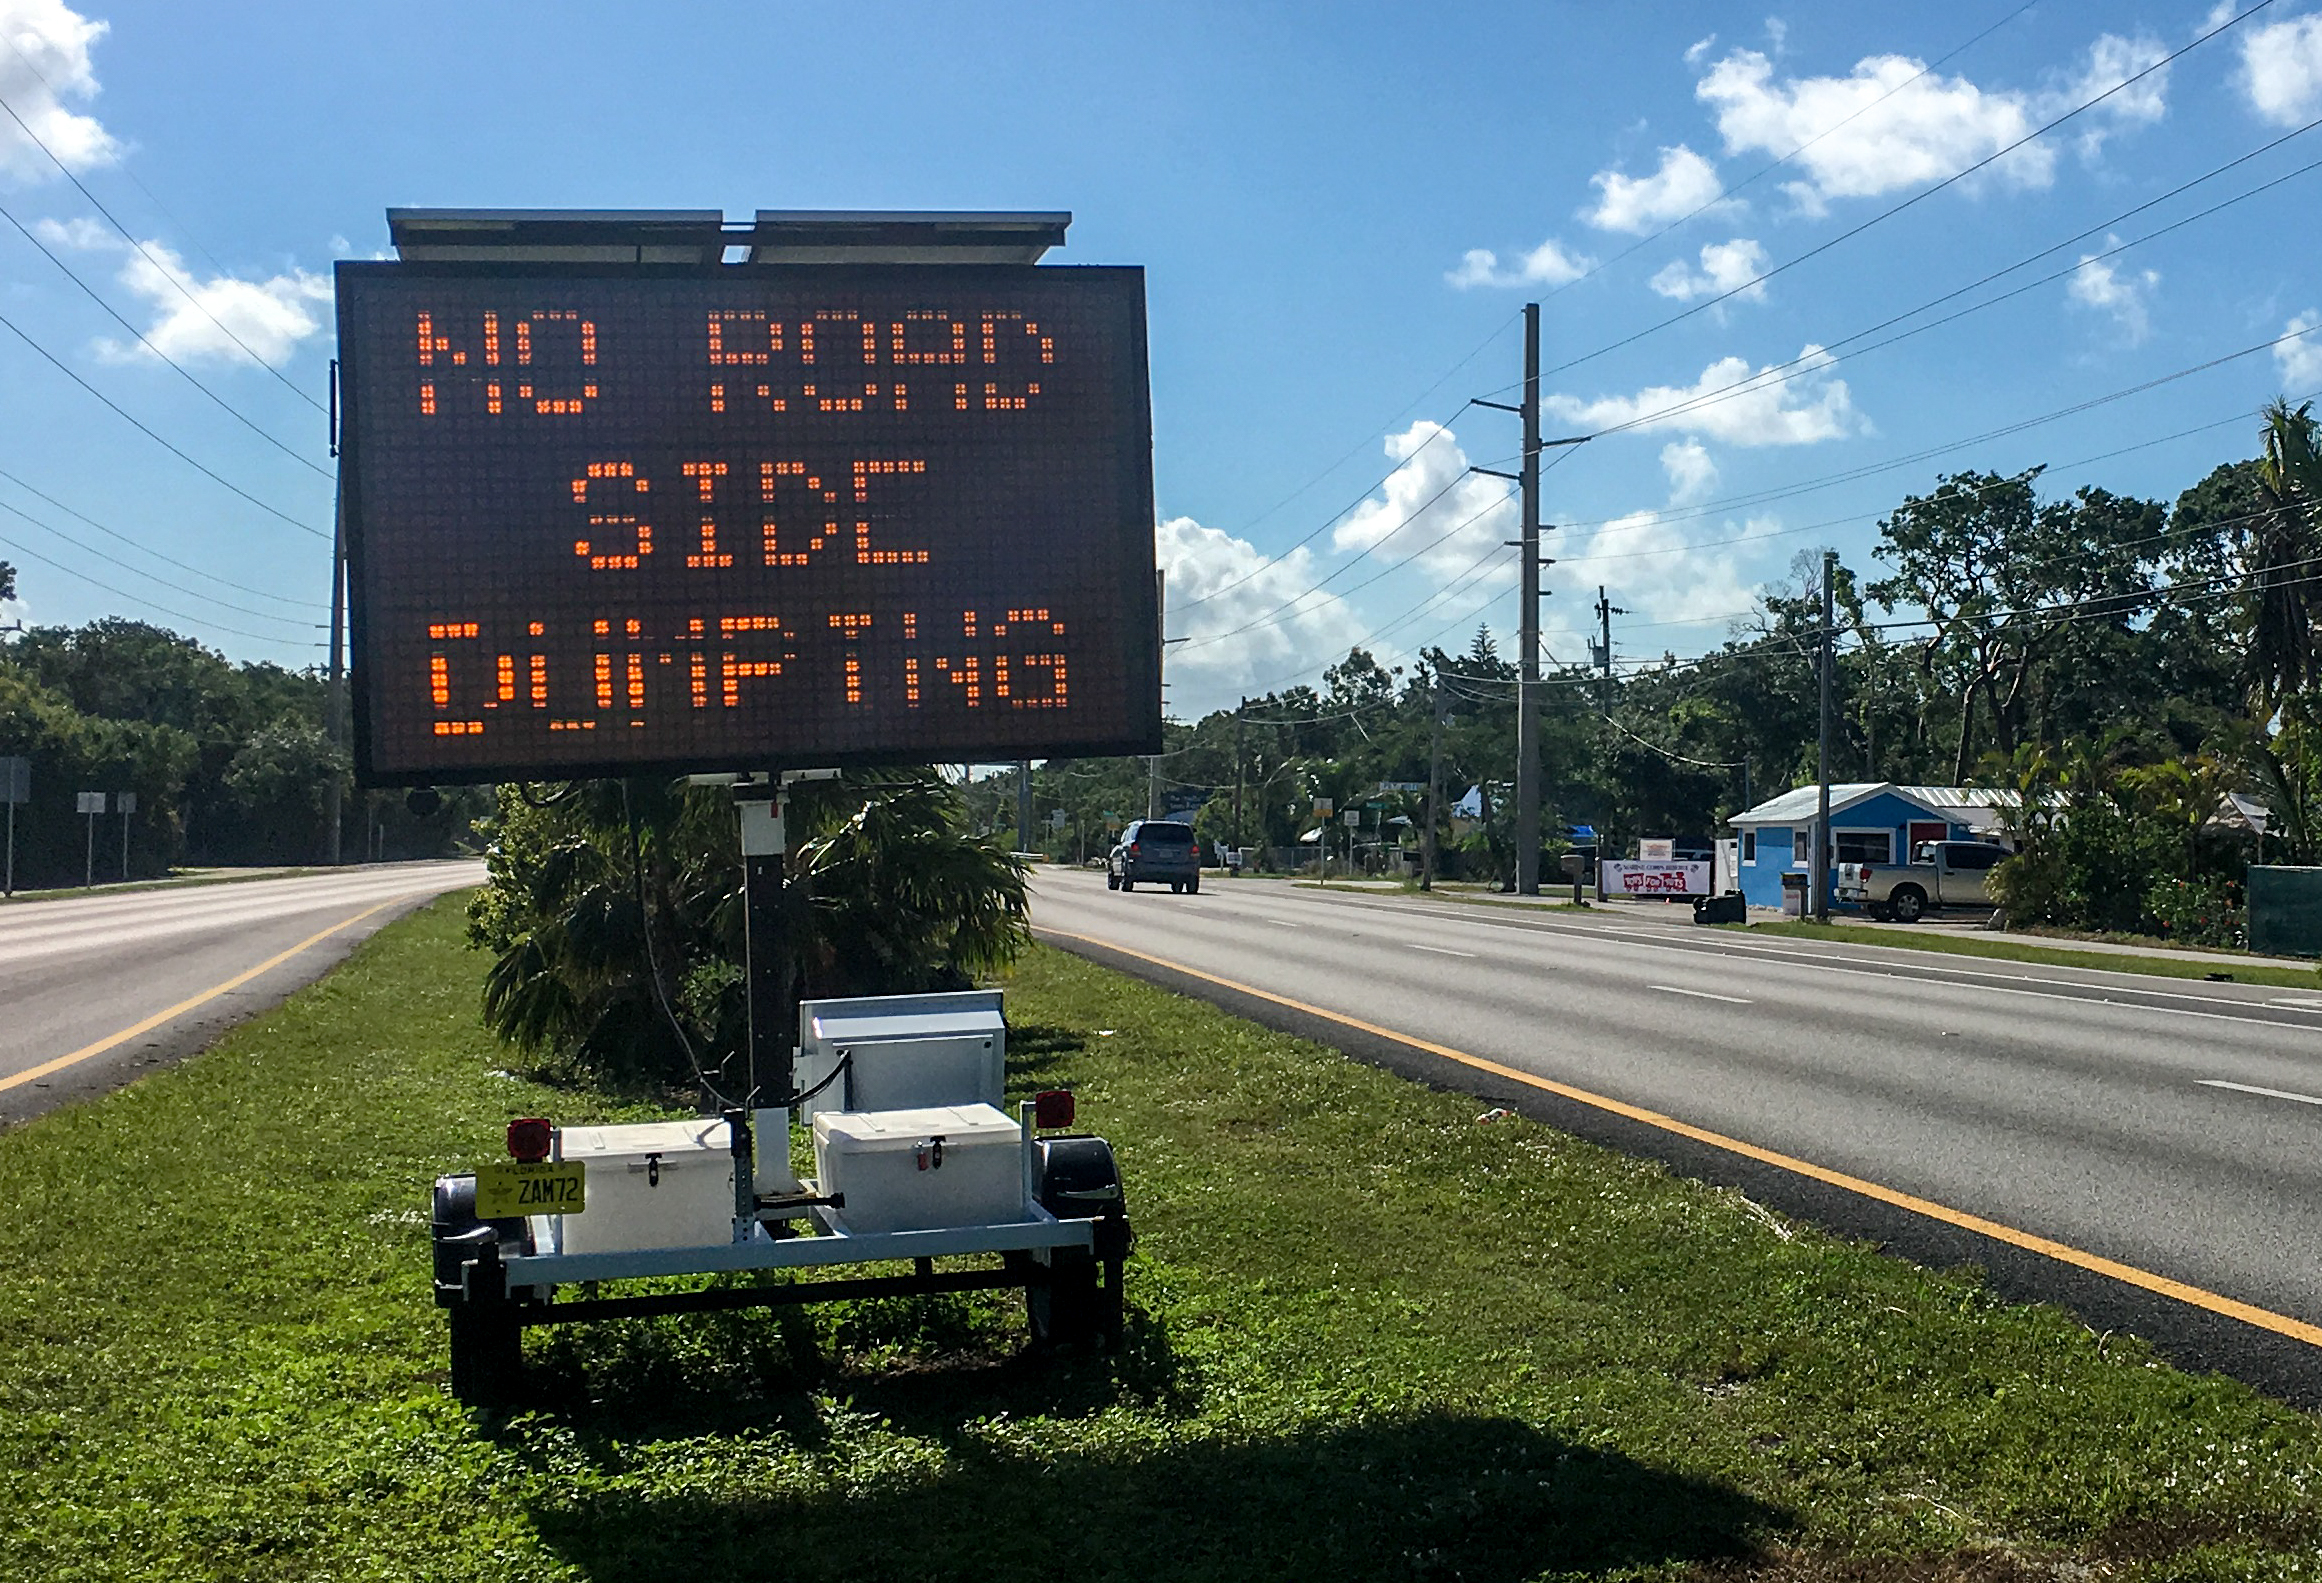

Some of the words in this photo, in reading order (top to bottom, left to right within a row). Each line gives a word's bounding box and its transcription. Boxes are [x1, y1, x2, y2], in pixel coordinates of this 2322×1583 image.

[417, 309, 597, 415] NO
[707, 309, 1054, 412] ROAD
[571, 459, 929, 570] SIDE
[427, 607, 1067, 736] DUMPING
[518, 1177, 578, 1204] ZAM72
